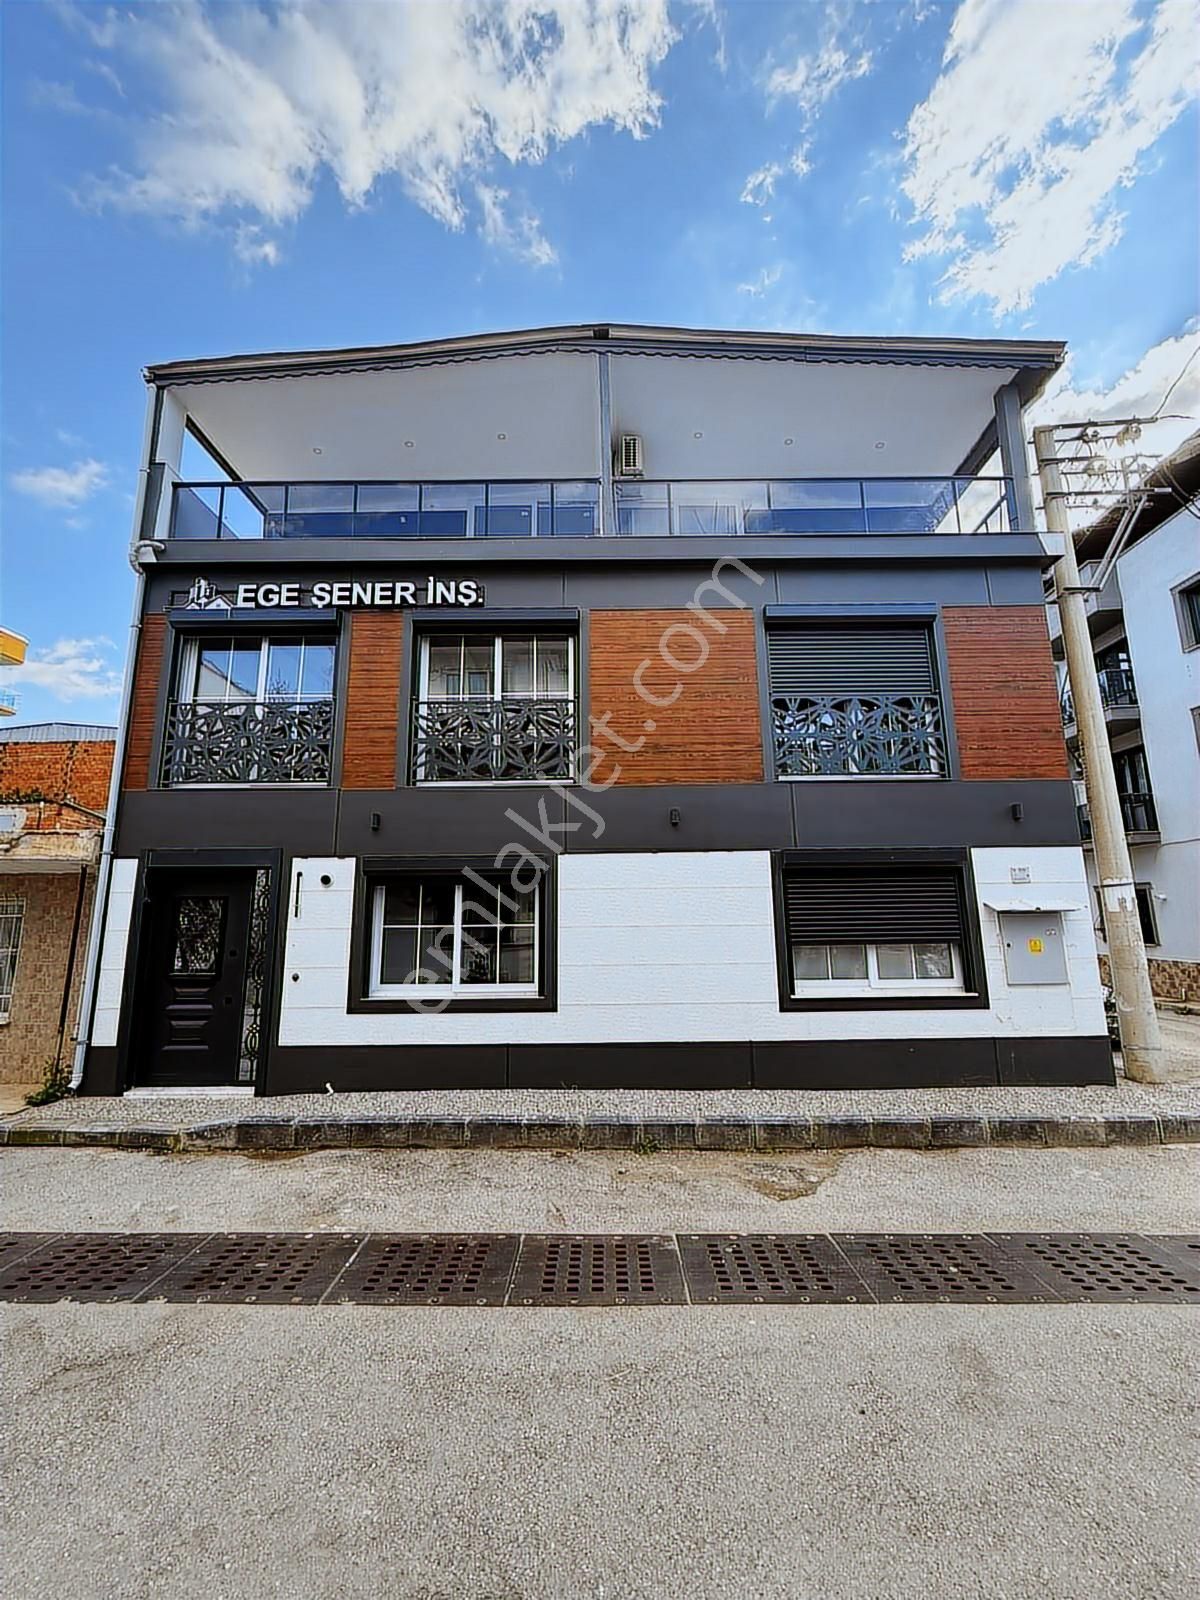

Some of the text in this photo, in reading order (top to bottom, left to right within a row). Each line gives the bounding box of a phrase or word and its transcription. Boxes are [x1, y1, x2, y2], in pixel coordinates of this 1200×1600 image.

[237, 577, 484, 608] EGE ŞENER İNŞ.
